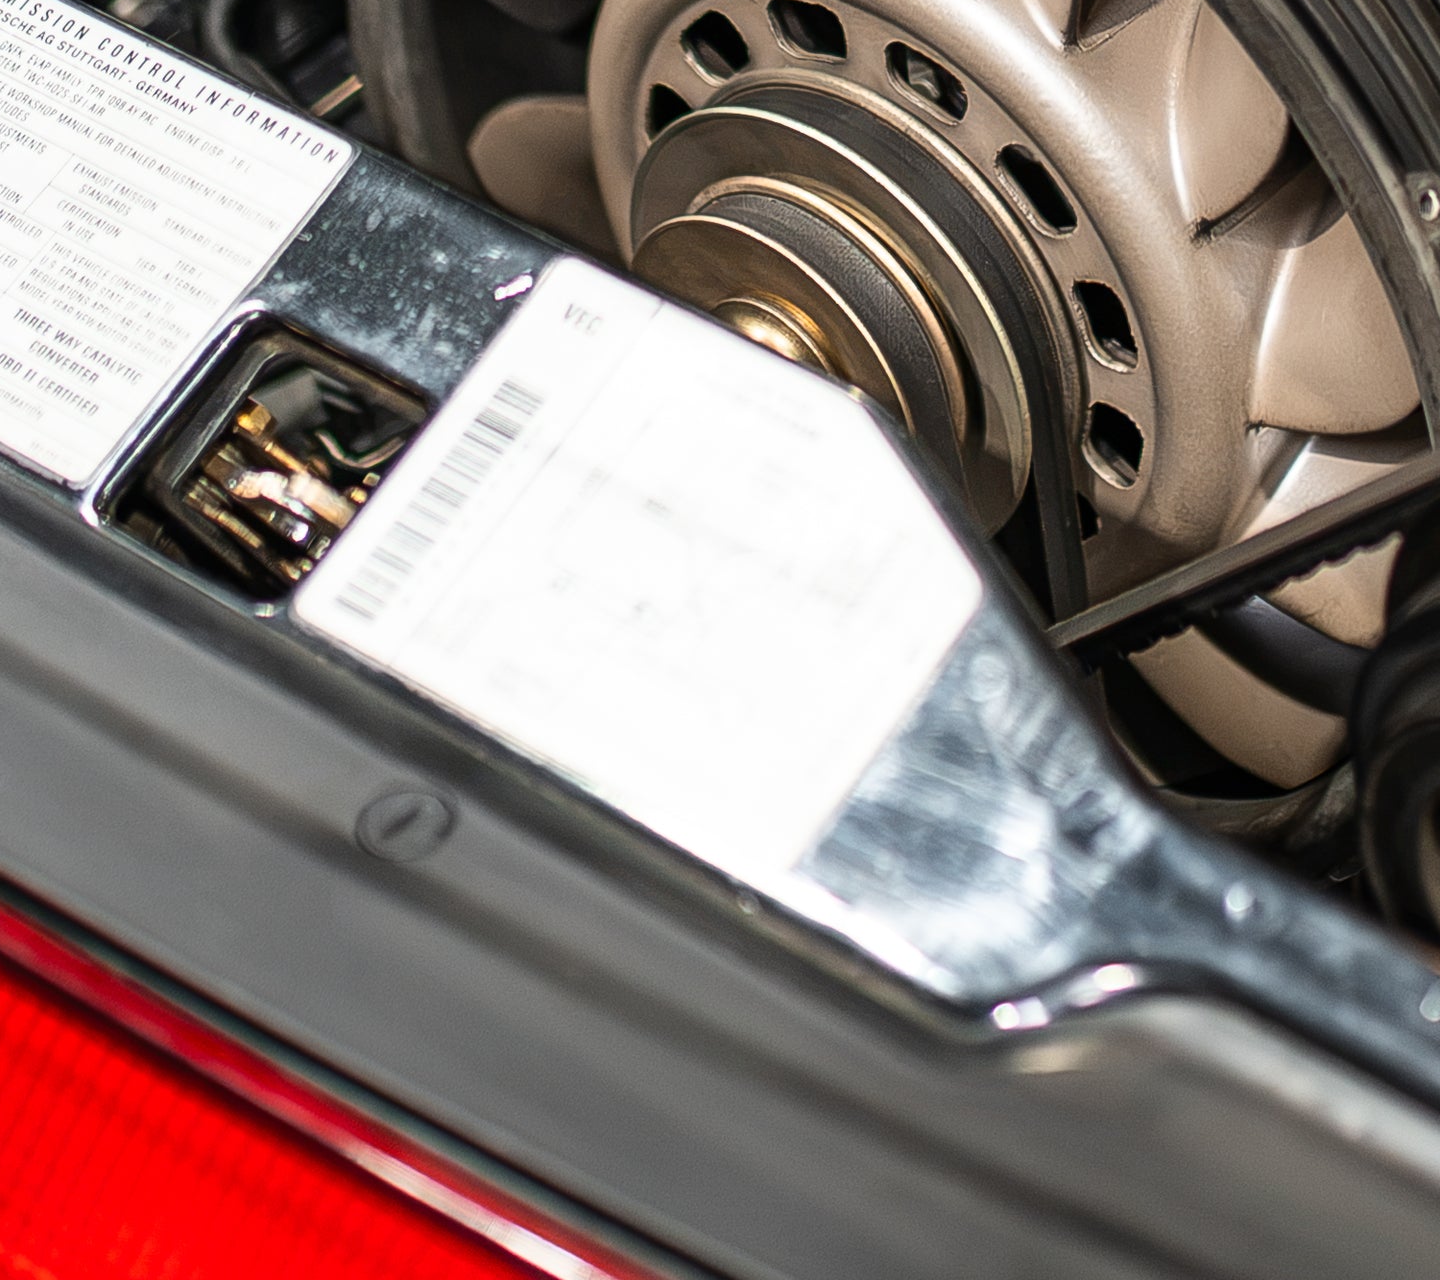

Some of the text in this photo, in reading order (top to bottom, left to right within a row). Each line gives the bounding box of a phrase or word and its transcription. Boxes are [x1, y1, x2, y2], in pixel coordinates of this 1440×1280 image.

[25, 53, 53, 72] EVAP
[84, 83, 107, 100] TPR
[136, 110, 160, 127] PAC
[34, 29, 57, 46] AG
[54, 39, 128, 82] STUTTGART
[132, 78, 199, 117] GERMANY
[94, 35, 190, 90] CONTROL
[193, 84, 341, 165] INFORMATION
[3, 86, 59, 120] WORKSHOP
[53, 111, 97, 139] MANUAL
[92, 131, 116, 149] FOR
[111, 141, 158, 171] DETAILED
[152, 162, 217, 201] ADJUSTMENT
[71, 161, 161, 213] EXHAUST EMISSION
[76, 182, 133, 218] STANDARDS
[54, 197, 124, 239] CERTIFICATION
[48, 241, 74, 259] THIS
[69, 252, 110, 279] VEHICLE
[75, 274, 99, 292] AND
[16, 279, 52, 304] MODEL
[71, 309, 97, 329] NEW
[92, 321, 130, 346] MOTOR
[26, 267, 92, 307] REGULATIONS
[11, 307, 144, 387] THREE WAY CATALYTIC
[25, 339, 101, 386] CONVERTER
[21, 367, 38, 383] II
[34, 375, 101, 419] CERTIFIED
